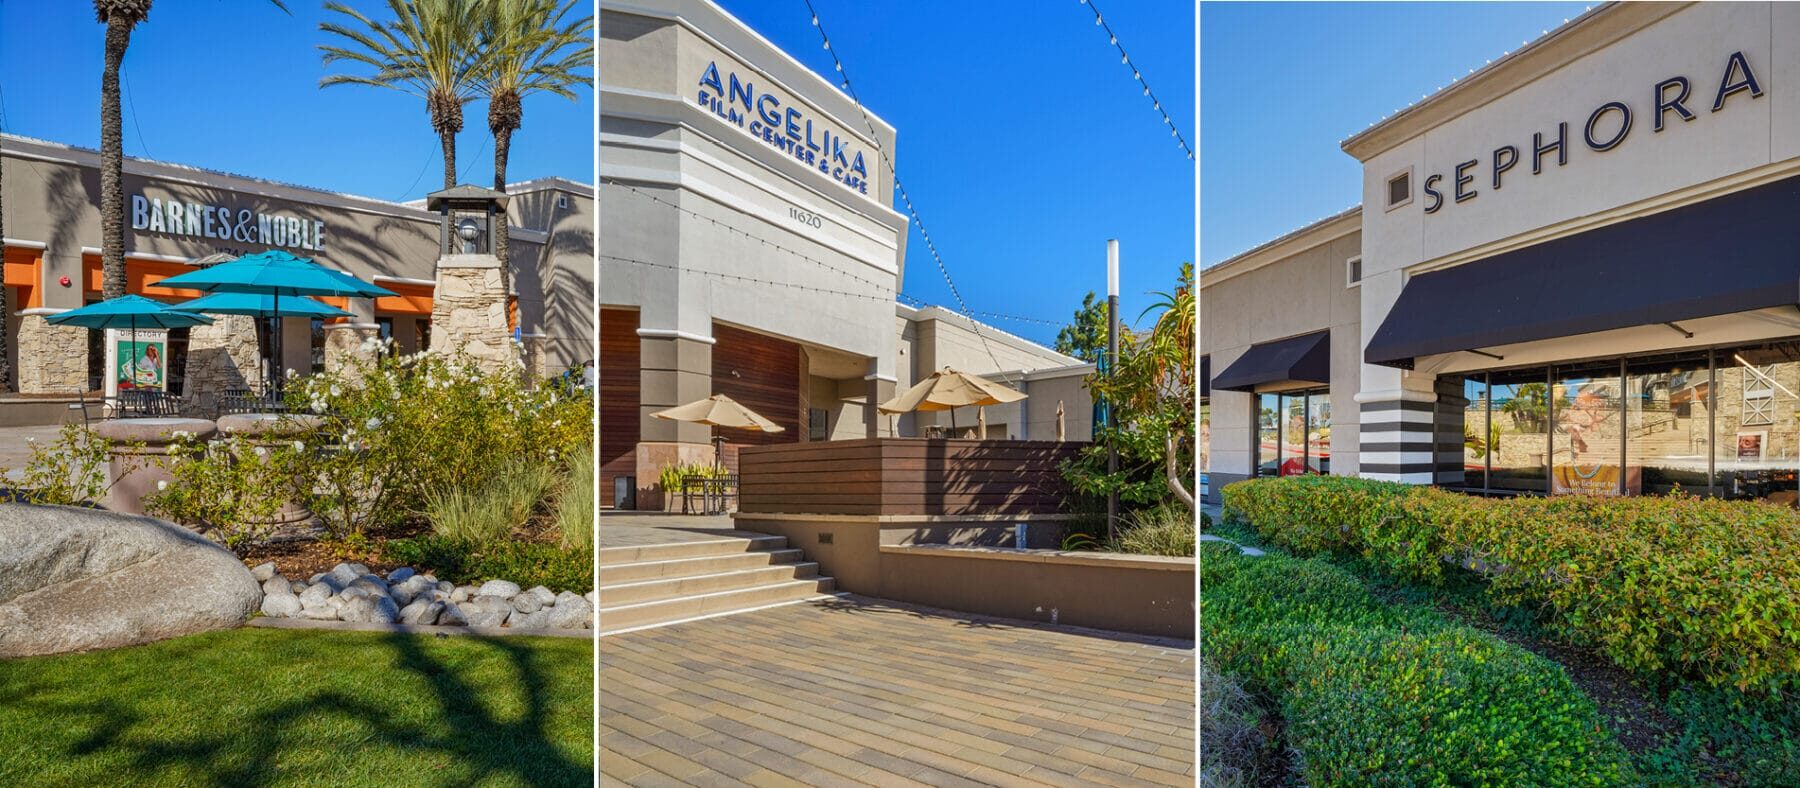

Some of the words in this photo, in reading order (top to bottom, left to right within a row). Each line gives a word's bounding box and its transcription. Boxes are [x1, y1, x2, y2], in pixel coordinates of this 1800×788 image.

[698, 90, 744, 128] FILM
[750, 120, 815, 167] CENTER
[818, 159, 830, 174] &
[832, 167, 868, 195] CAFE
[699, 61, 868, 179] ANGELIKA
[1424, 51, 1764, 214] SEPHORA
[789, 207, 822, 229] 11620
[1556, 486, 1594, 495] Something
[1569, 479, 1580, 487] We
[1581, 480, 1606, 488] Belong
